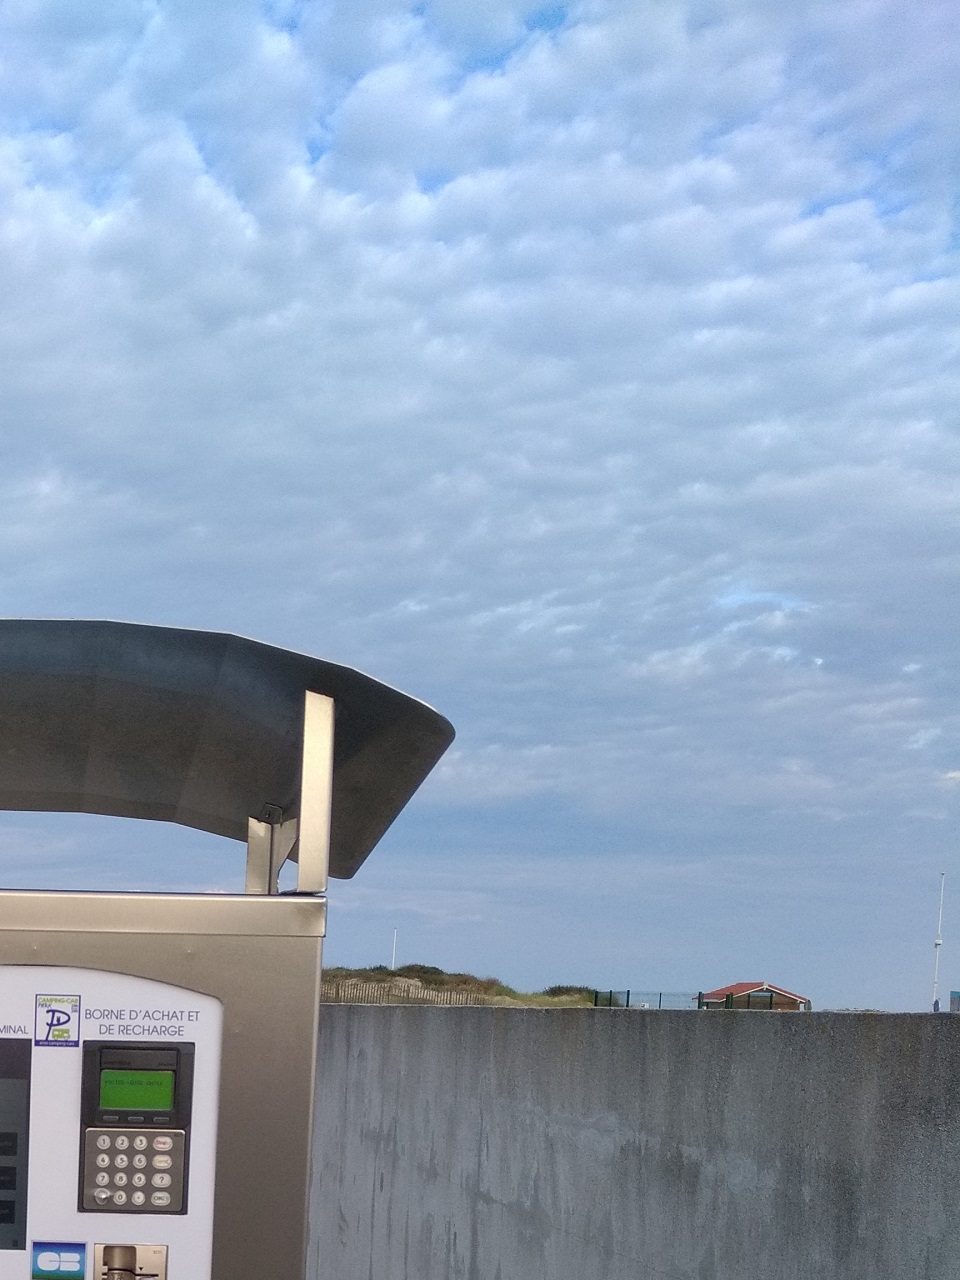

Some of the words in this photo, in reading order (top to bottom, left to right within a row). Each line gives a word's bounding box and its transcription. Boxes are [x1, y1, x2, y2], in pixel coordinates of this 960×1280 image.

[84, 1008, 126, 1020] BORNE
[128, 1009, 186, 1022] D'ACHAT
[187, 1010, 201, 1022] ET
[98, 1024, 115, 1035] DE
[117, 1024, 185, 1037] RECHARGE
[37, 1251, 81, 1272] CB
